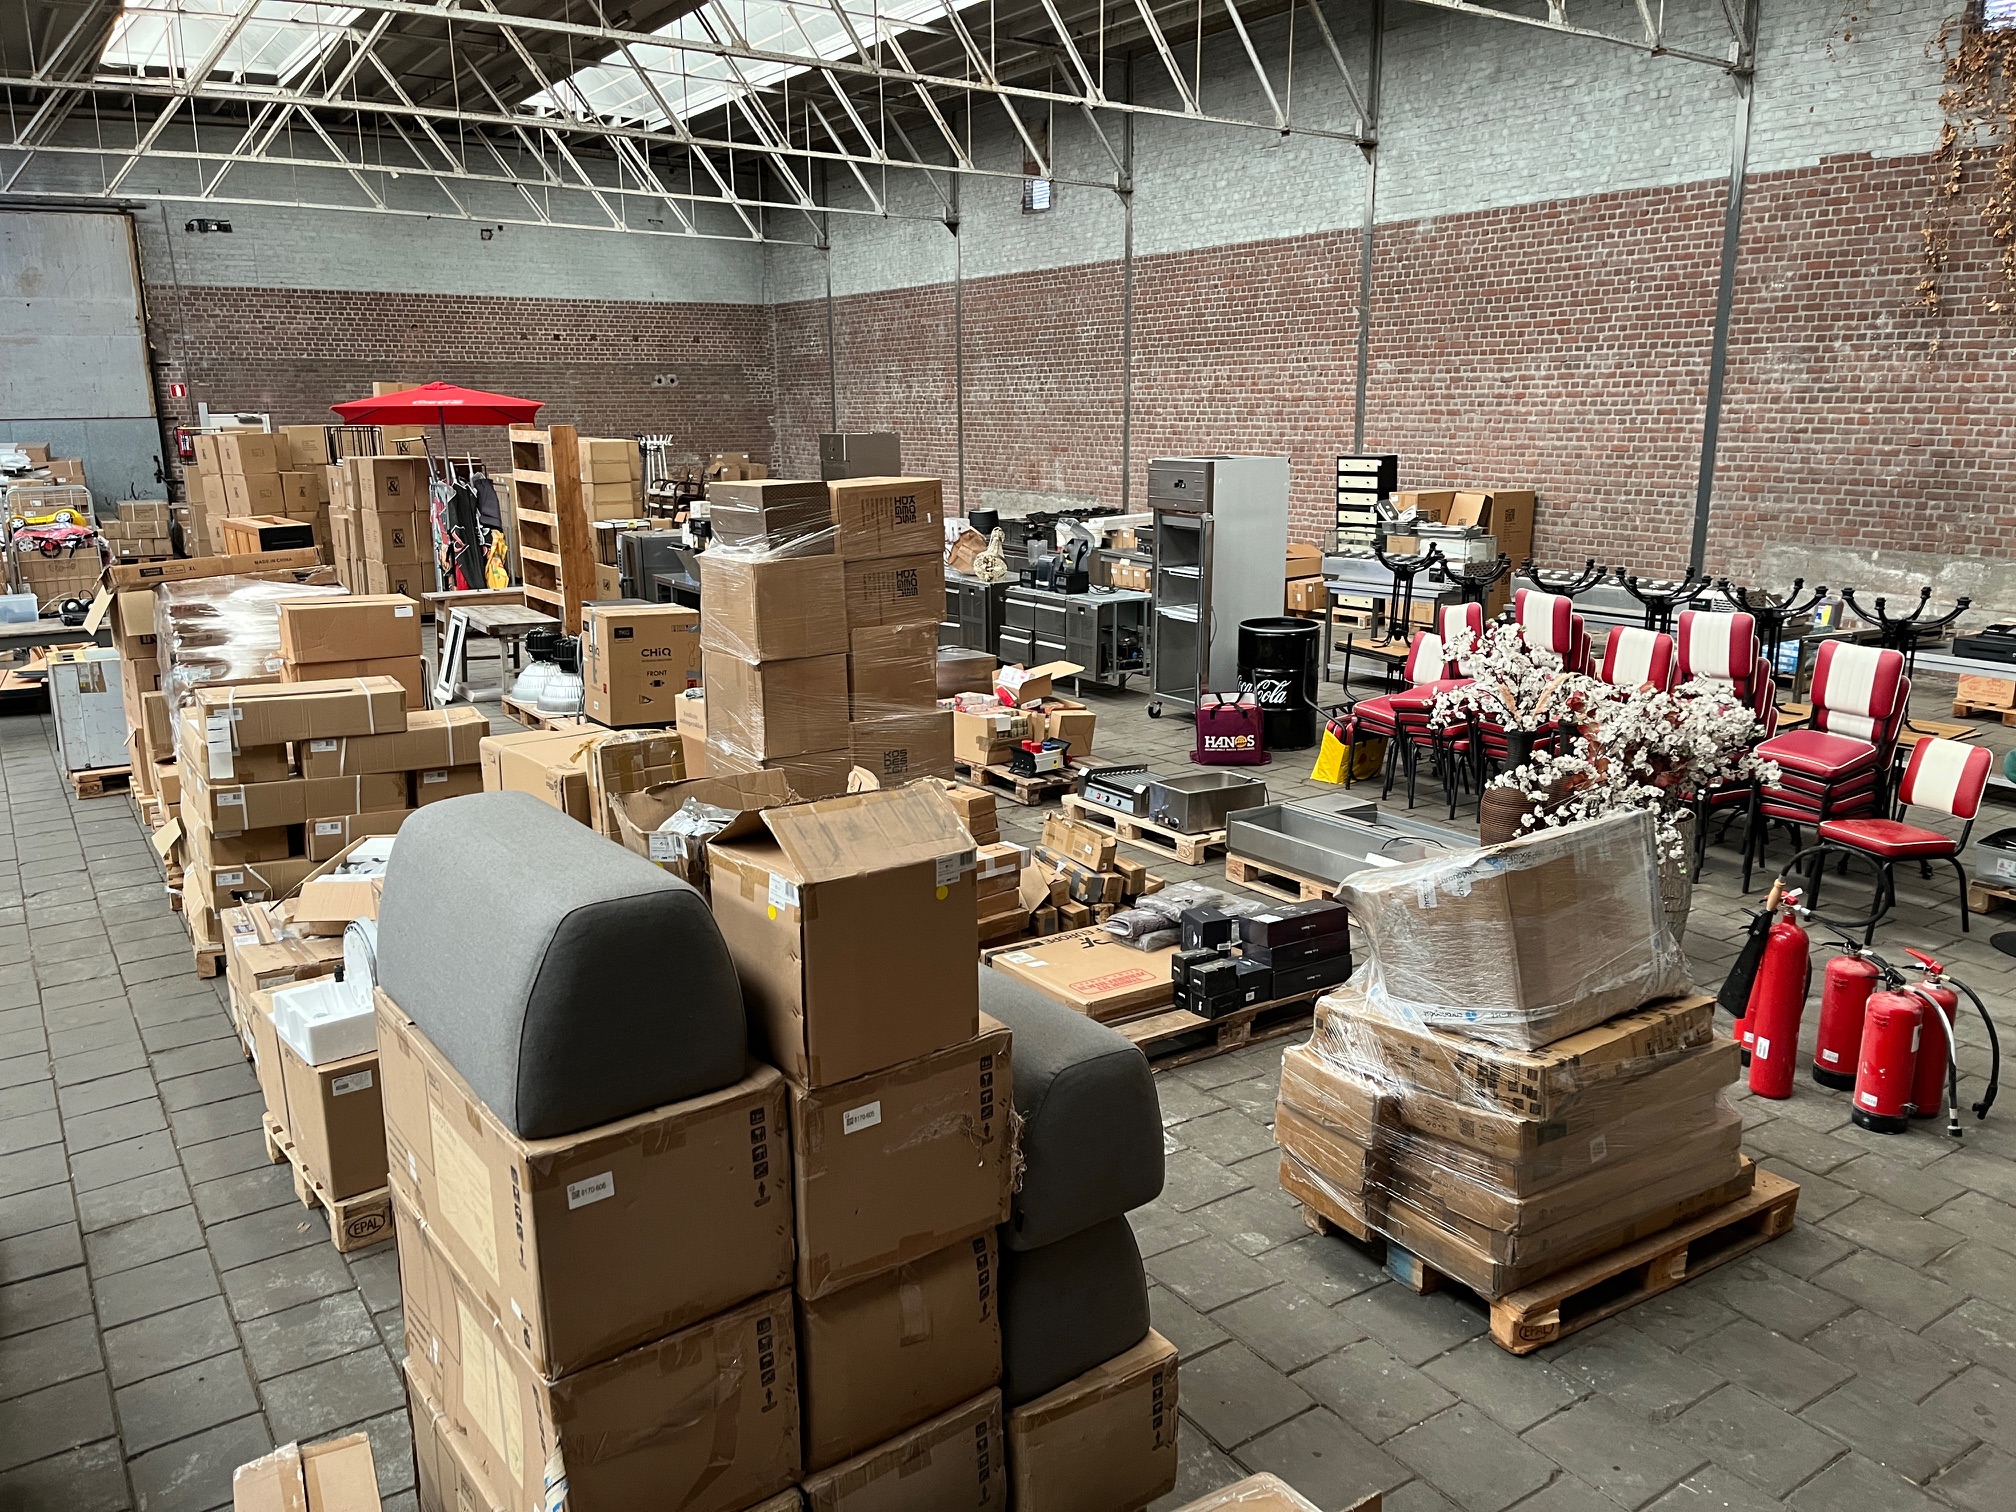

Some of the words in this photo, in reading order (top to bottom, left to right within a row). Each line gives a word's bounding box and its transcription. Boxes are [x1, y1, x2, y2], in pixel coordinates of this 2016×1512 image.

[1204, 734, 1255, 748] HANOS
[1045, 929, 1095, 944] EUROPE
[353, 1217, 381, 1236] EPAL
